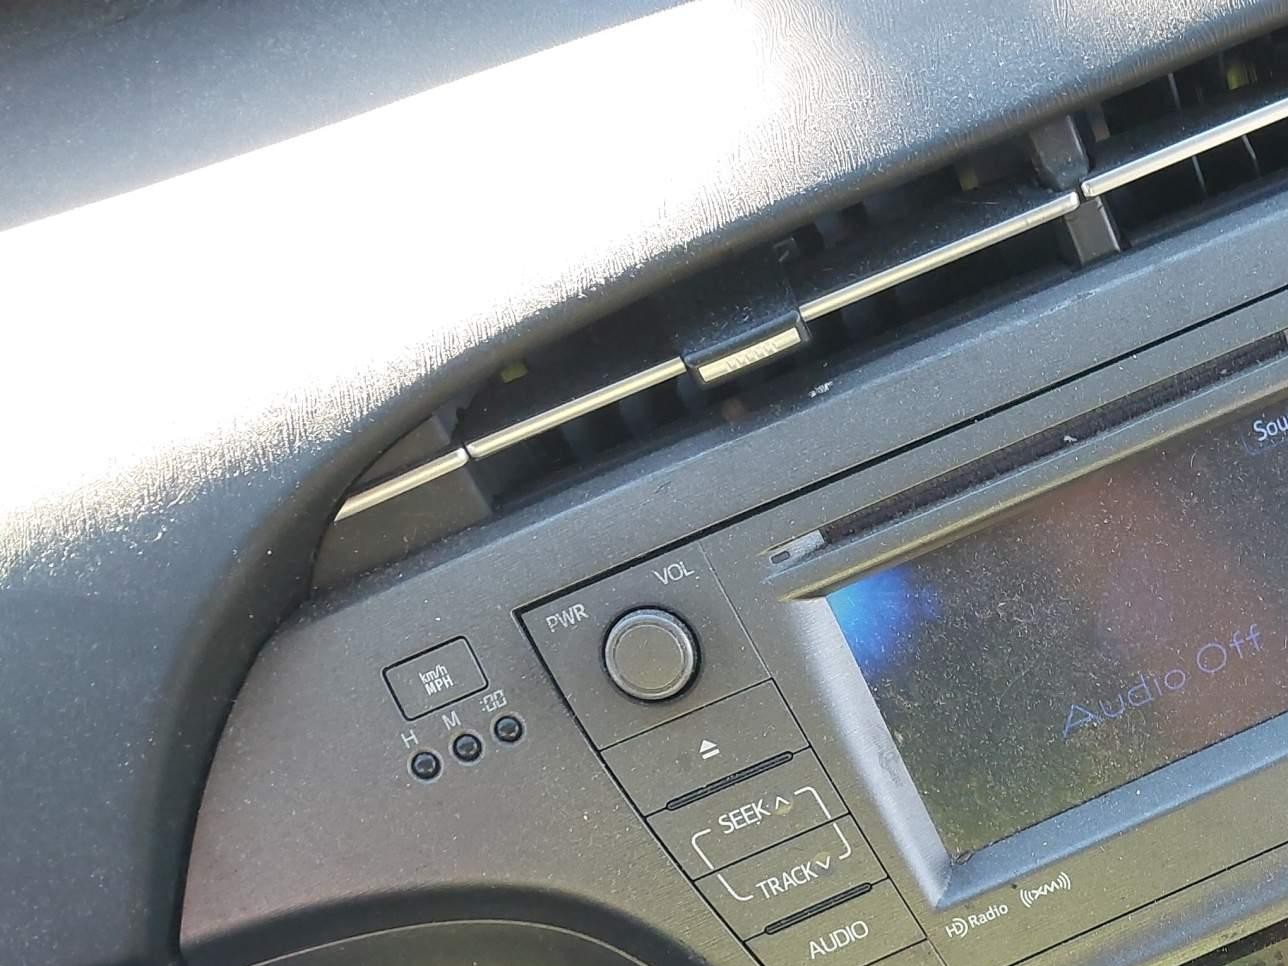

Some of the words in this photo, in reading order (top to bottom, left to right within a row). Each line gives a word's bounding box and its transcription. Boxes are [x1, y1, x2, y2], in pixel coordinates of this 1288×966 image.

[654, 560, 695, 587] VOL
[545, 603, 589, 633] PWR
[418, 664, 448, 684] km/h
[424, 674, 454, 696] MPH
[1063, 669, 1187, 738] Audio
[1196, 624, 1264, 674] Off
[441, 711, 461, 730] M
[401, 729, 418, 748] H
[718, 798, 770, 836] SEEK
[755, 865, 819, 901] TRACK
[967, 904, 1009, 929] Radio
[807, 920, 870, 960] AUDIO
